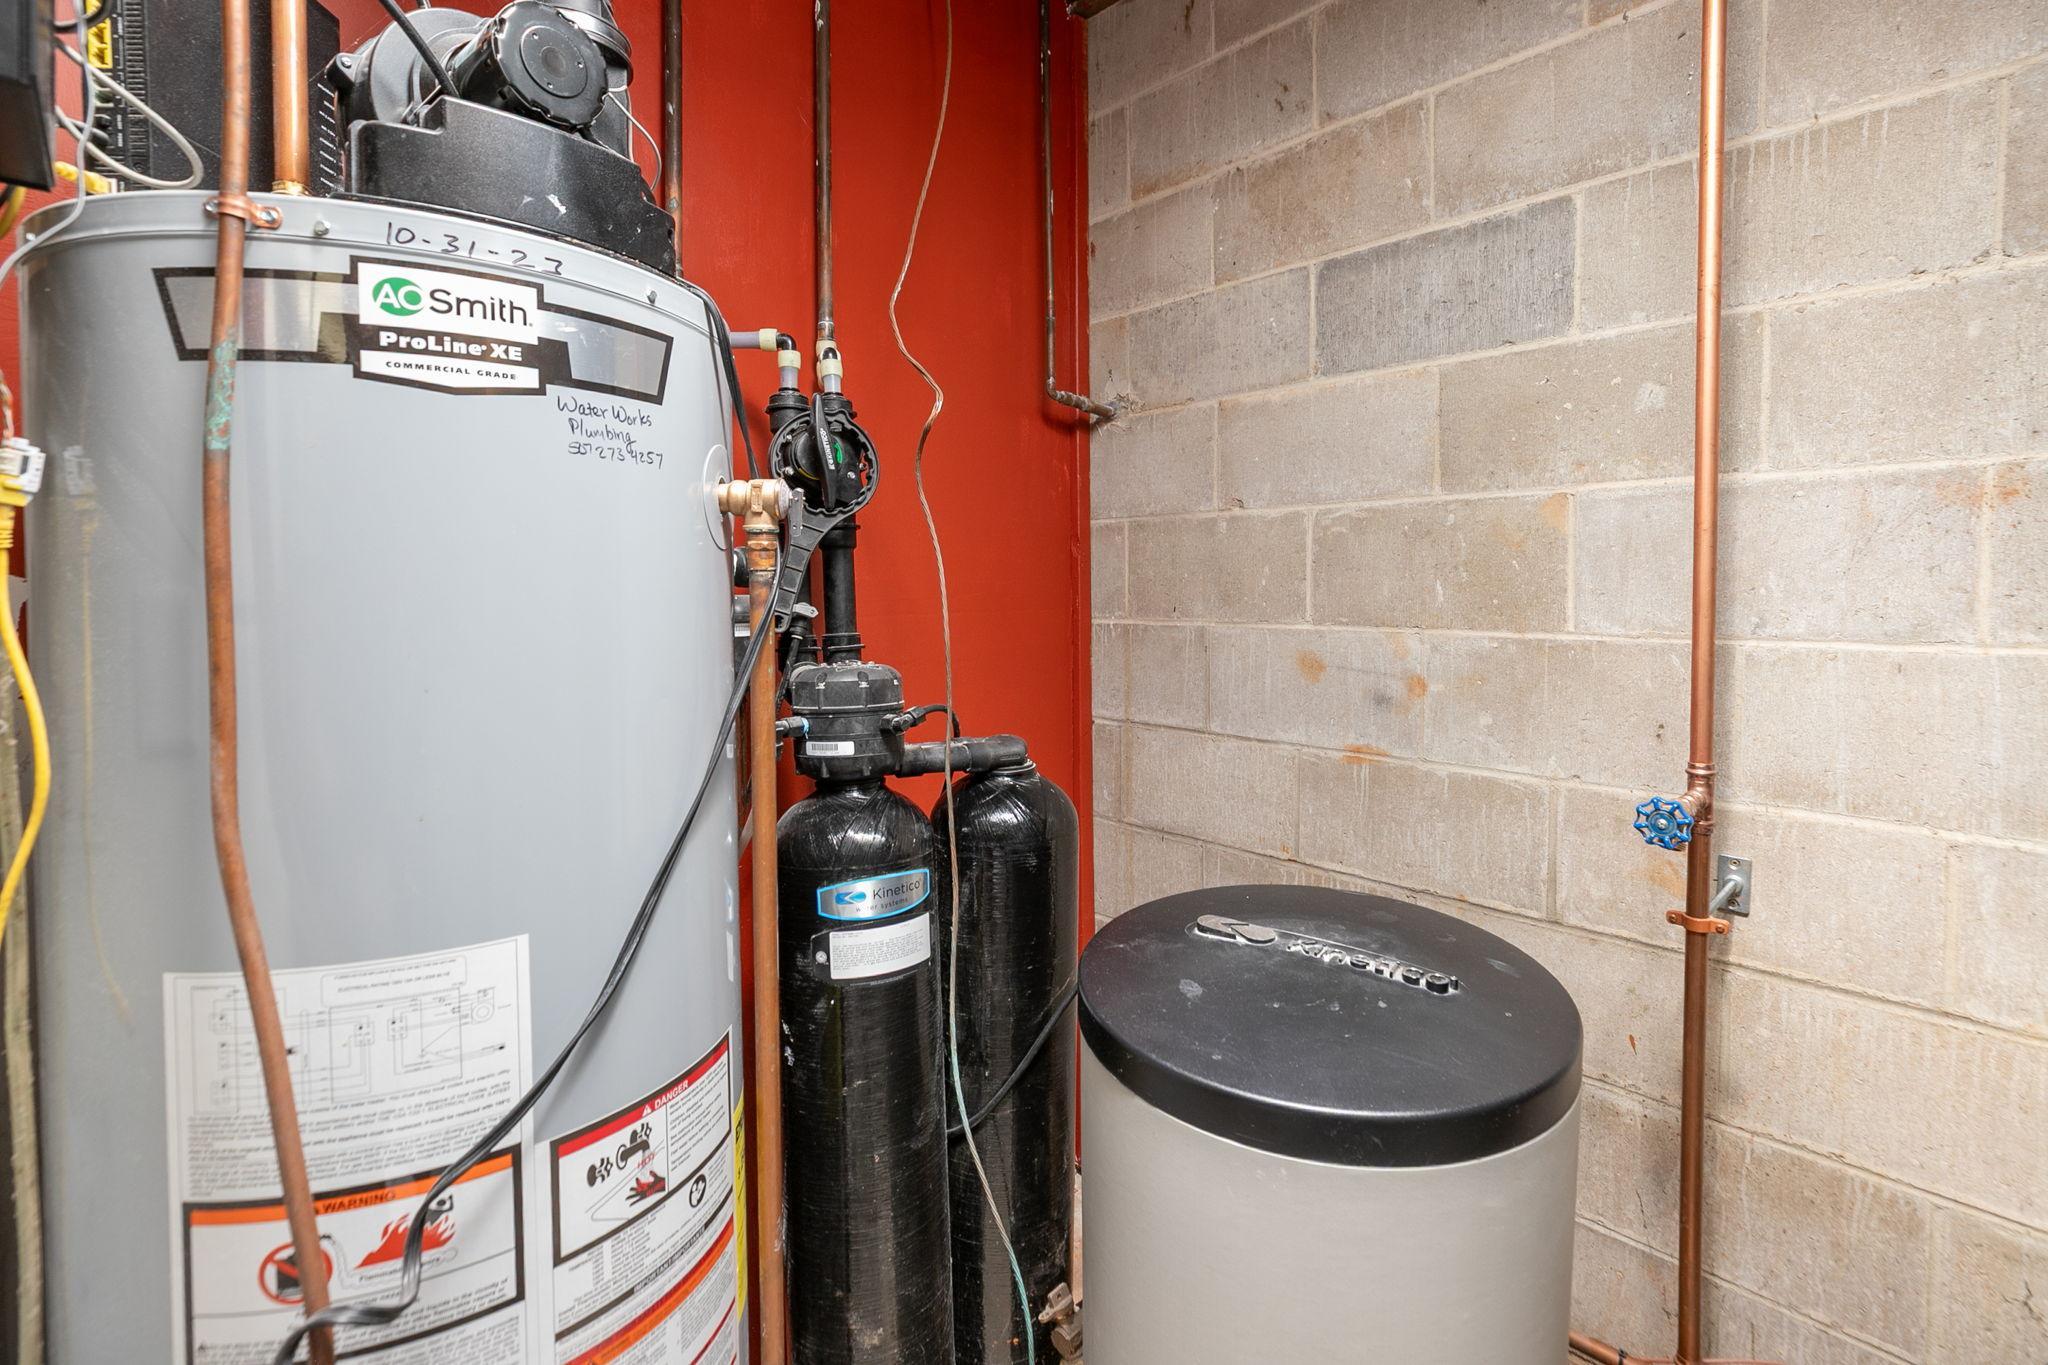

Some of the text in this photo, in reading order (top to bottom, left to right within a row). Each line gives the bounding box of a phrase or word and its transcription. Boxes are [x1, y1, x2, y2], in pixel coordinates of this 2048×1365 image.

[429, 289, 528, 327] Smith
[379, 331, 523, 361] ProLine XE
[385, 361, 517, 381] COMMERCIAL GRADE
[558, 396, 653, 427] Water Works
[568, 417, 635, 452] Plumbing
[595, 446, 626, 462] 273
[630, 451, 663, 470] 4257
[872, 880, 921, 900] Kinetico
[655, 1079, 689, 1110] DANGER
[322, 1190, 395, 1214] WARNING
